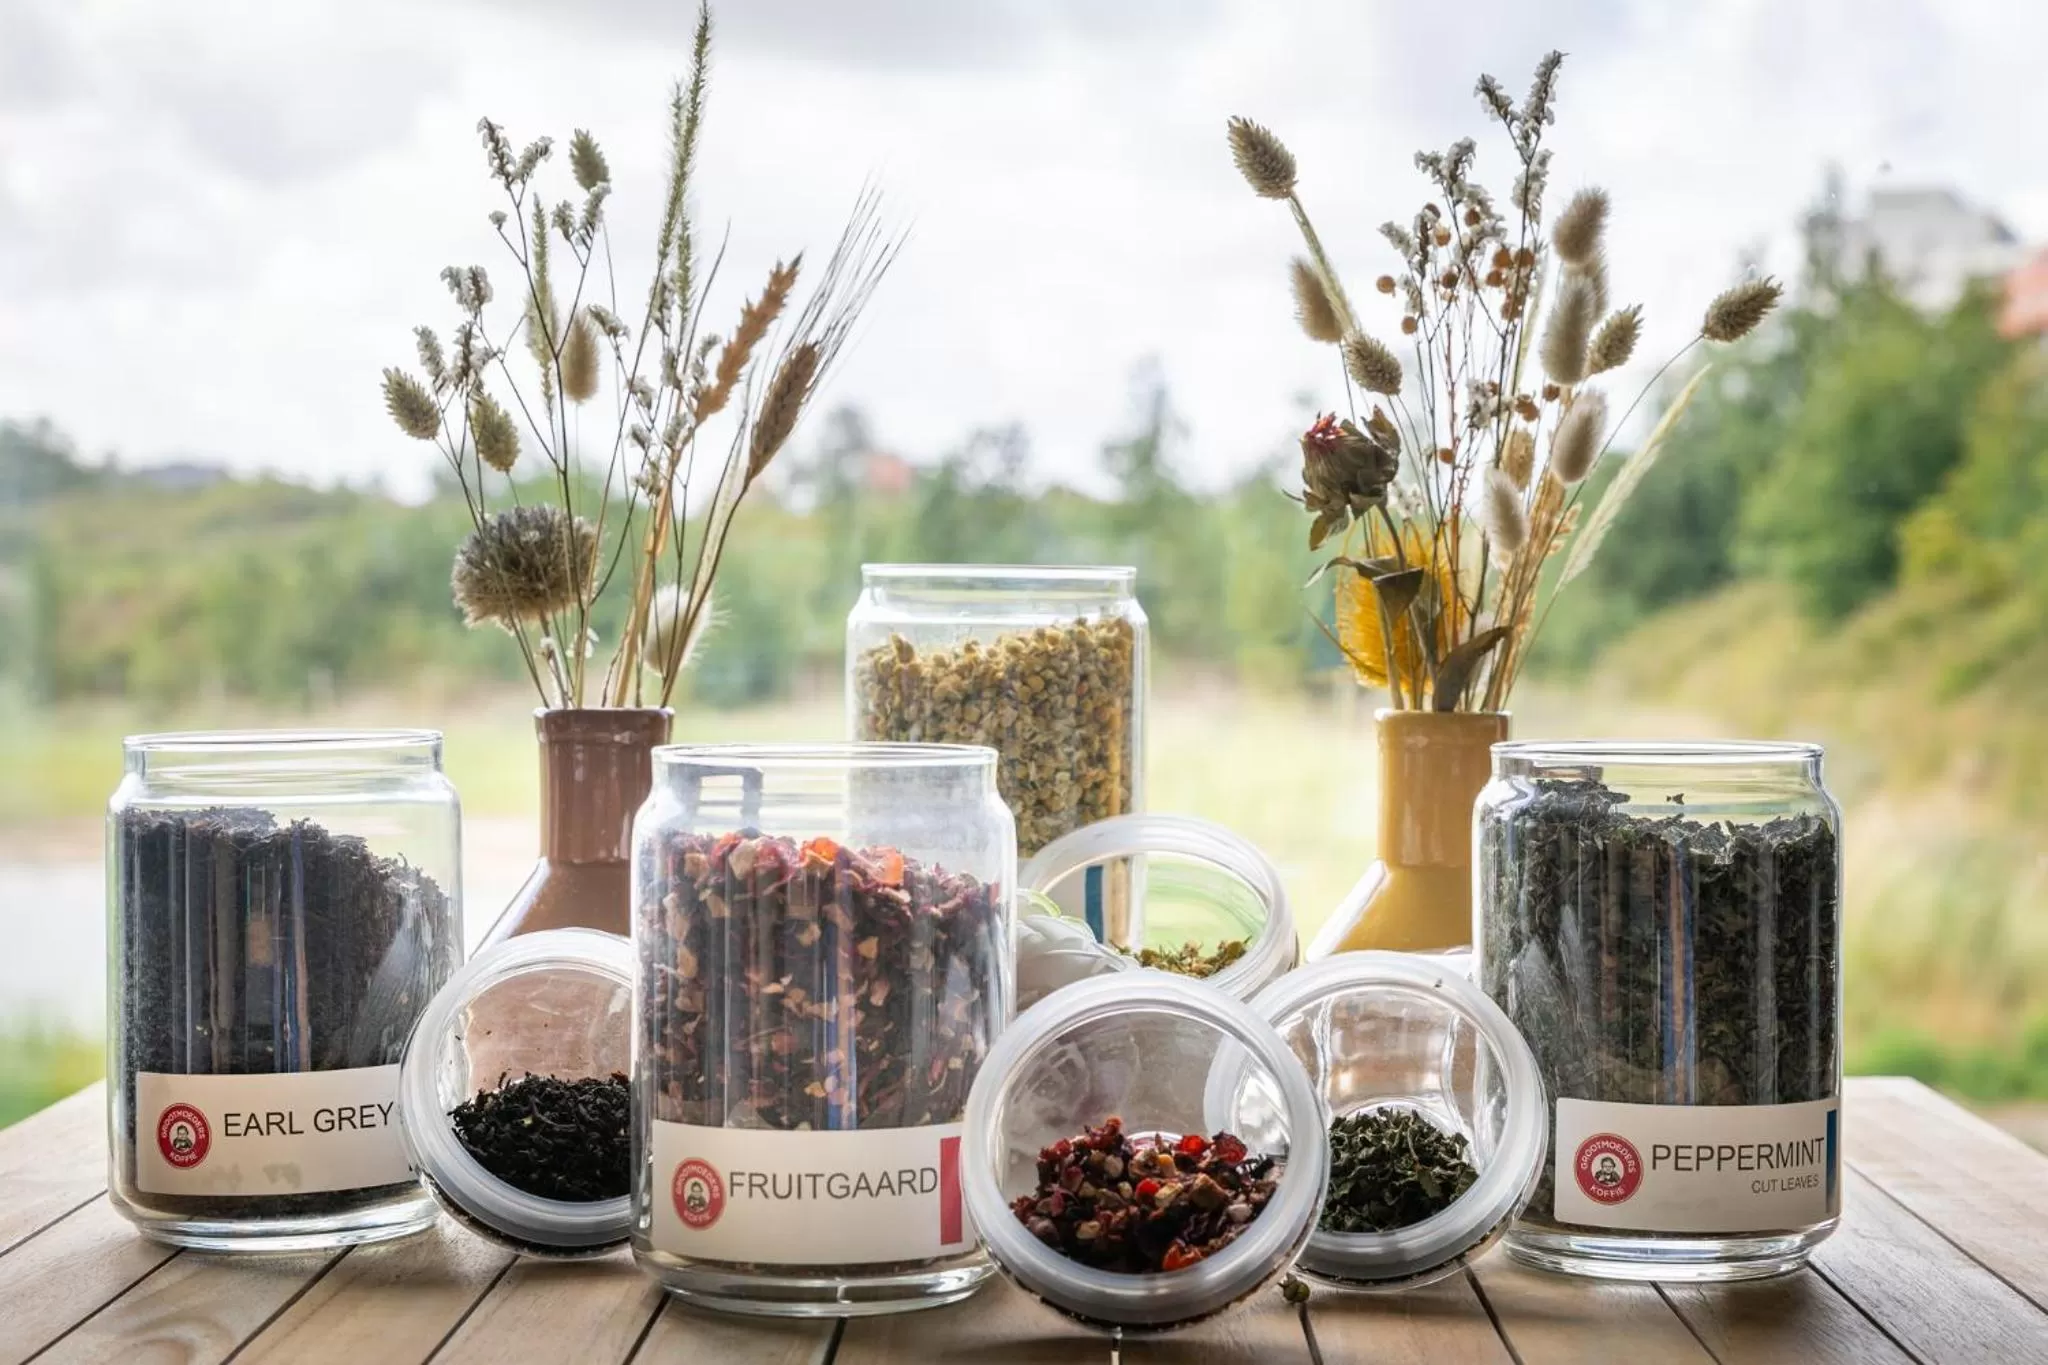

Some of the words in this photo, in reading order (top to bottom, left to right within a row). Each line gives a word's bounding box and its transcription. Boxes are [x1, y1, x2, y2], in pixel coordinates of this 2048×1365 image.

[224, 1111, 303, 1137] EARL
[313, 1101, 394, 1132] GREY
[1580, 1140, 1637, 1174] GROOTMOEDERS
[1652, 1137, 1825, 1172] PEPPERMINT
[729, 1167, 938, 1199] FRUITGAARD
[1590, 1184, 1626, 1198] KOFFIE
[1751, 1178, 1778, 1194] CUT
[1781, 1174, 1820, 1192] LEAVES
